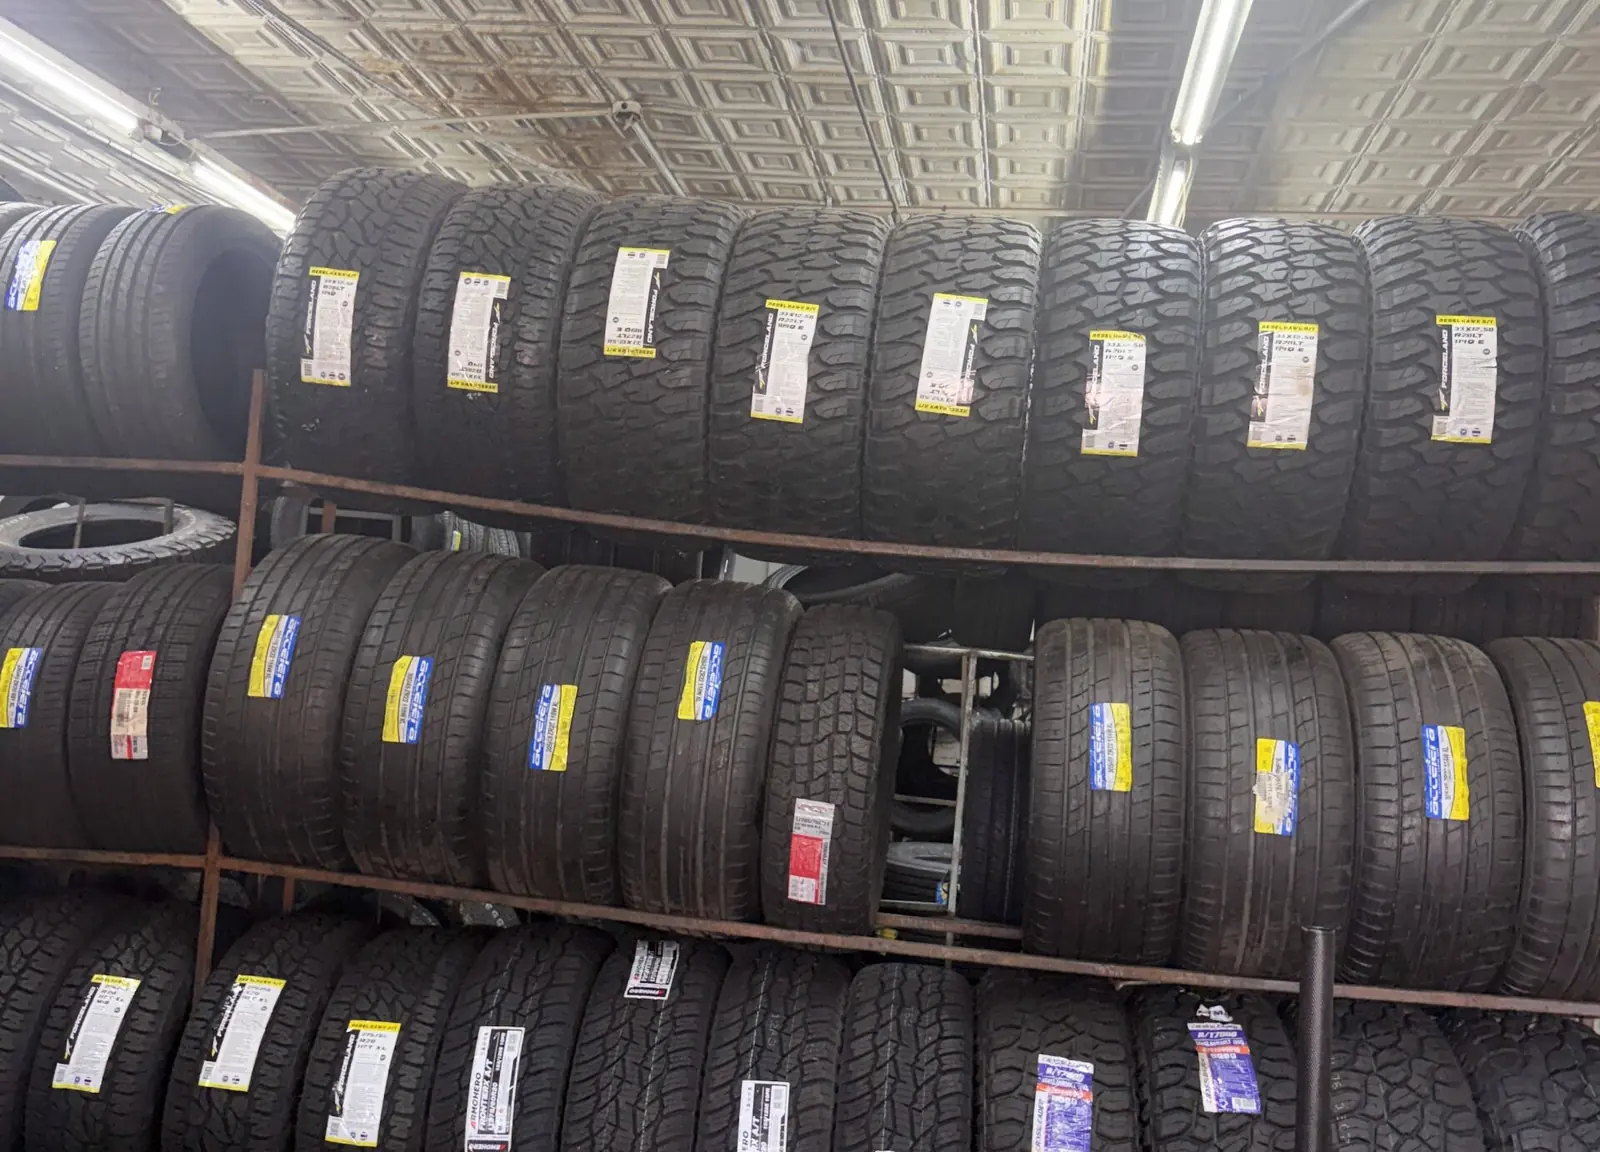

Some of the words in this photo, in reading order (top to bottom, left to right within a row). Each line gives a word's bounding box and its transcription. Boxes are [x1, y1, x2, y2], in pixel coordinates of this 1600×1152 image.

[647, 289, 658, 344] FORCELAND
[760, 313, 774, 369] FORCELAND
[1441, 329, 1449, 388] FORCELAND
[17, 650, 38, 725] accelera
[273, 618, 298, 695] accelera
[705, 644, 722, 717] accelera
[409, 660, 429, 740] accelera
[532, 685, 551, 766] accelera
[1092, 705, 1103, 787] accelera
[1425, 728, 1439, 815] accelera
[70, 986, 96, 1039] FORCELAND
[471, 1073, 481, 1128] ARMOHERO
[485, 1059, 493, 1078] A/T
